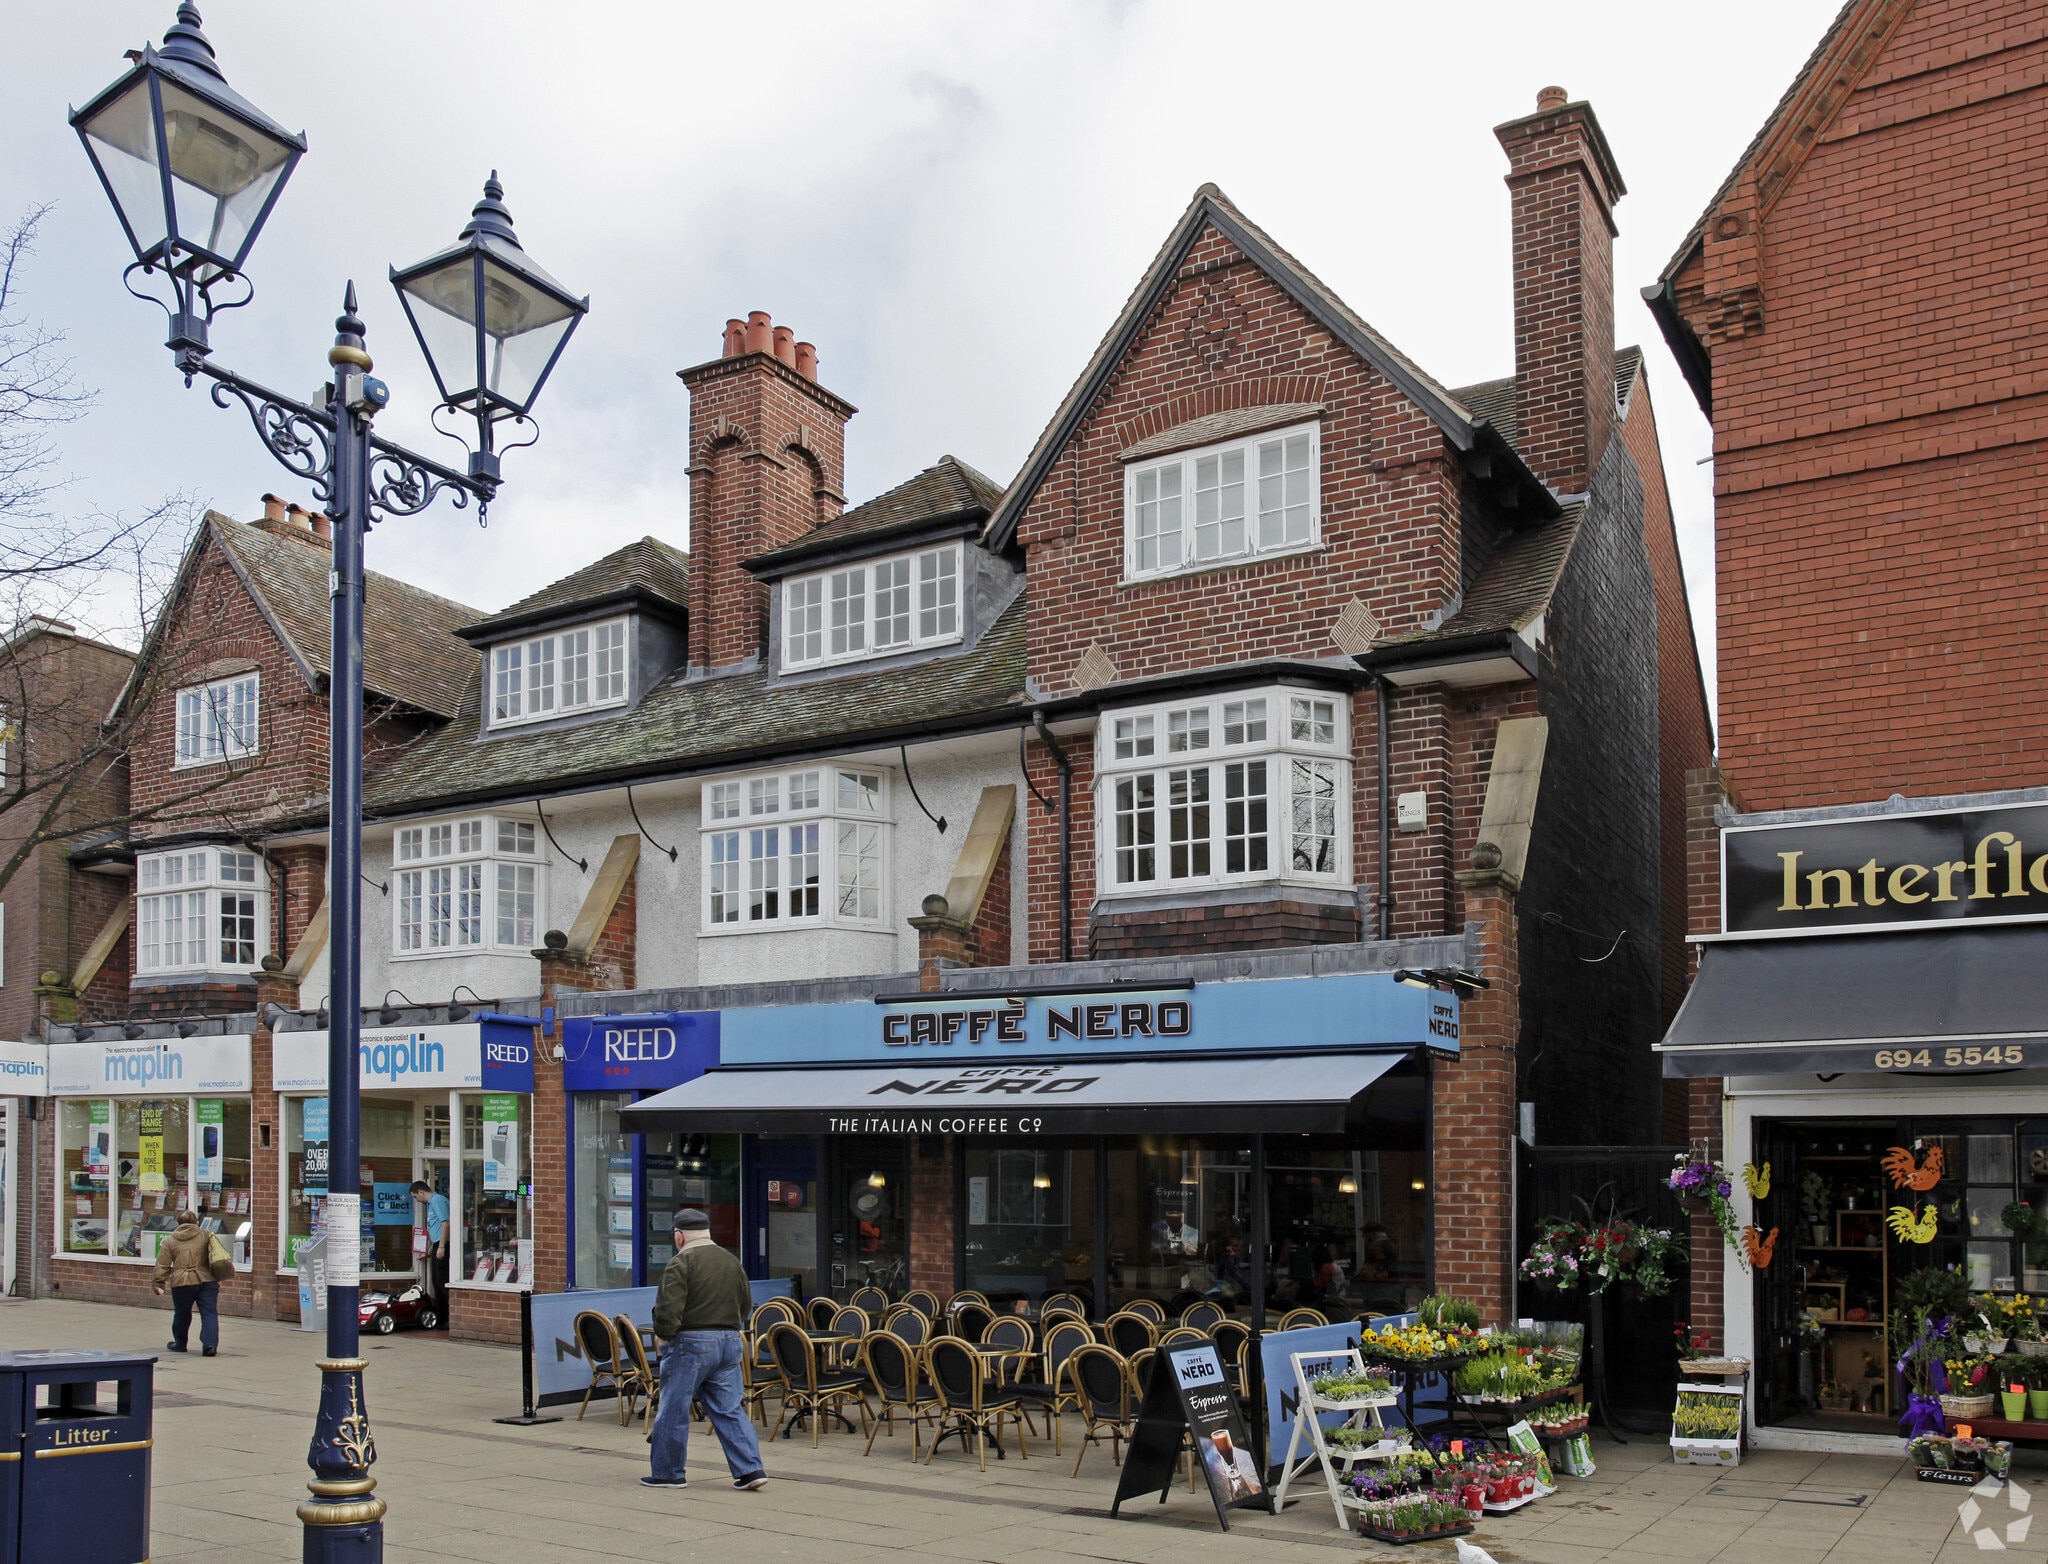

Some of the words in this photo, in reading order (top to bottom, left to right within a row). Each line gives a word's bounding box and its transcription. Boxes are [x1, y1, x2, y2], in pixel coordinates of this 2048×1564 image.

[1434, 1005, 1453, 1019] CAFFÈ
[882, 997, 1026, 1046] CAFFÈ
[1047, 1000, 1191, 1040] NERO
[1429, 1016, 1459, 1039] NERO
[605, 1027, 677, 1062] REED
[487, 1043, 528, 1064] REED
[1875, 1050, 1932, 1068] 694
[1944, 1045, 2023, 1066] 5545
[105, 1044, 183, 1088] maplin
[960, 1066, 1064, 1077] CAFFÈ
[52, 1084, 91, 1092] www.maplin.co.uk
[198, 1080, 243, 1088] www.maplin.co.uk
[277, 1077, 326, 1087] www.maplin.co.uk
[866, 1077, 1101, 1095] NERO
[141, 1110, 154, 1118] END
[155, 1109, 163, 1117] OF
[141, 1118, 163, 1127] RANGE
[829, 1118, 858, 1133] THE
[864, 1118, 932, 1133] ITALIAN
[939, 1118, 1008, 1133] COFFEE
[307, 1149, 328, 1160] OVER
[305, 1160, 328, 1172] 20,00
[377, 1201, 410, 1210] Collect
[1181, 1363, 1215, 1380] NERO
[1189, 1394, 1228, 1412] Espresso
[55, 1428, 110, 1446] Litter
[1919, 1470, 1973, 1483] Fleurs
